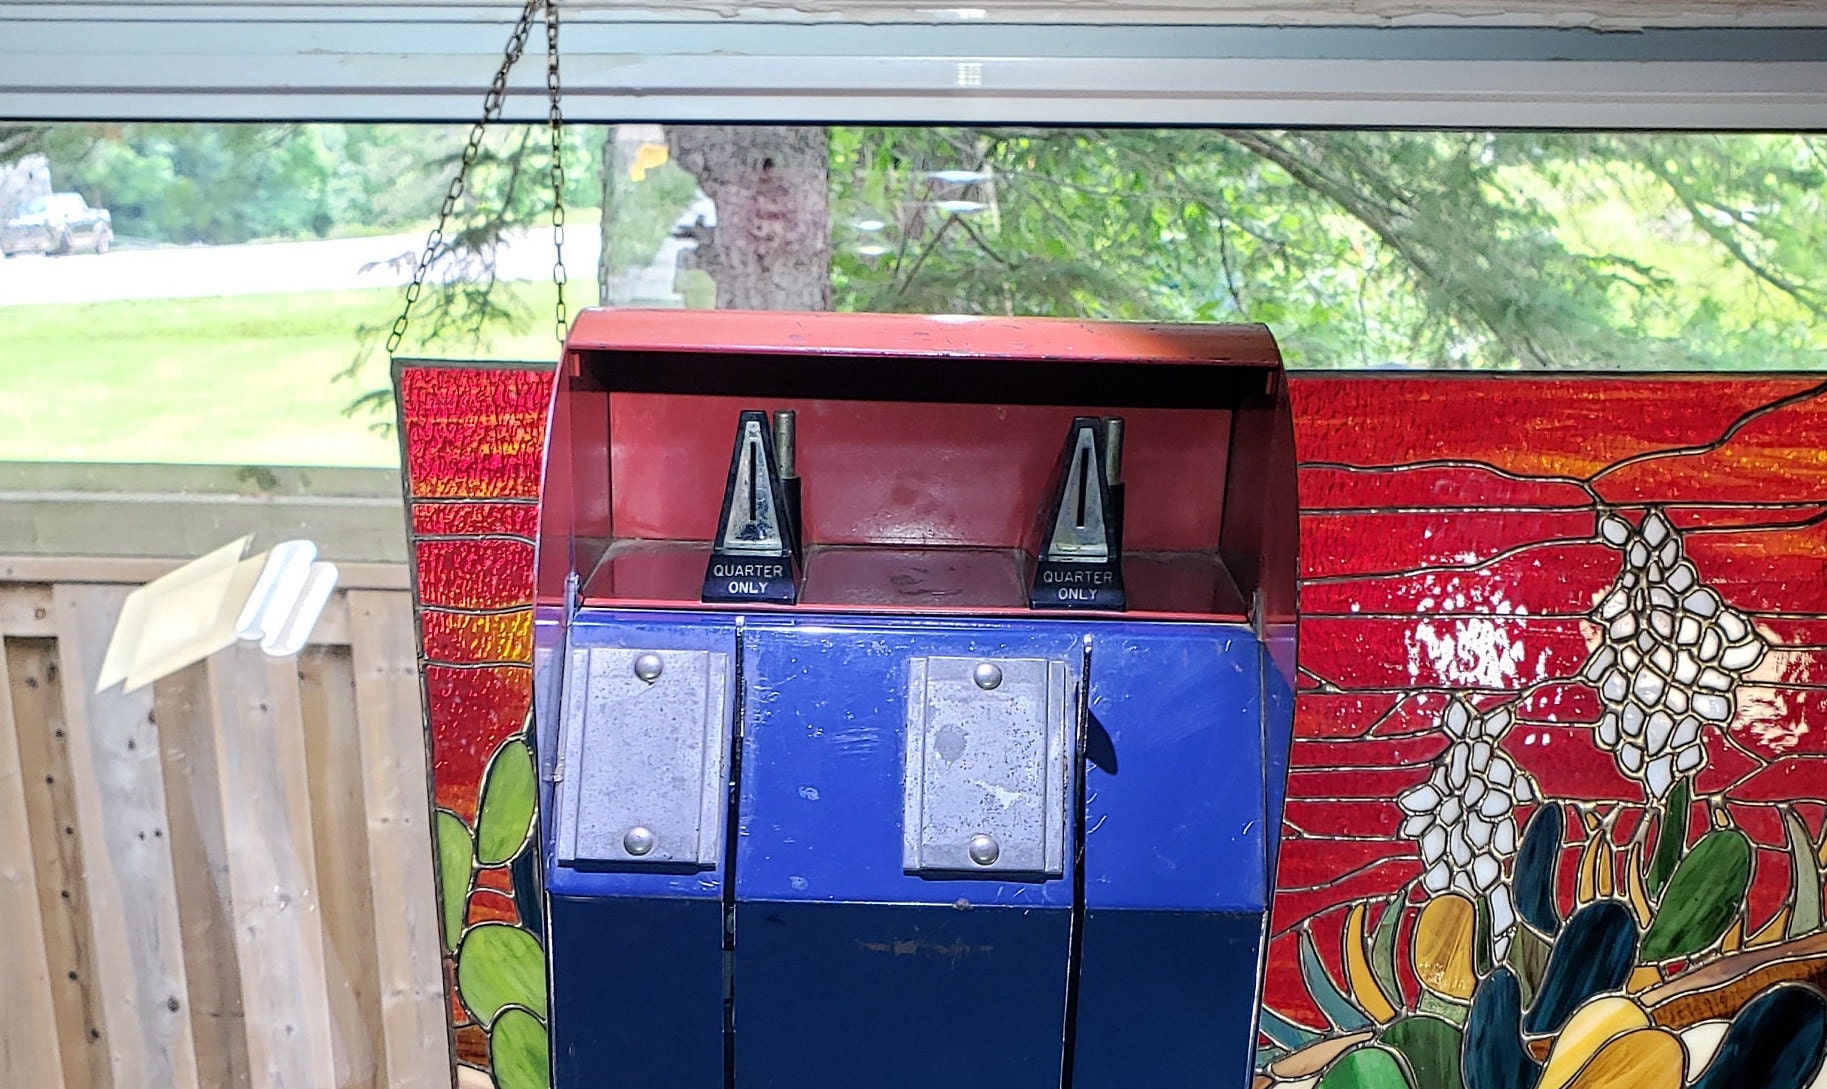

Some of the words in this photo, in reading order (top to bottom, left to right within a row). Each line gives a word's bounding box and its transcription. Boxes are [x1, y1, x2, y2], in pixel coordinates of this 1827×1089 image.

[713, 564, 783, 577] QUARTER
[1043, 571, 1113, 584] QUARTER
[728, 581, 768, 594] ONLY
[1058, 588, 1097, 600] ONLY
